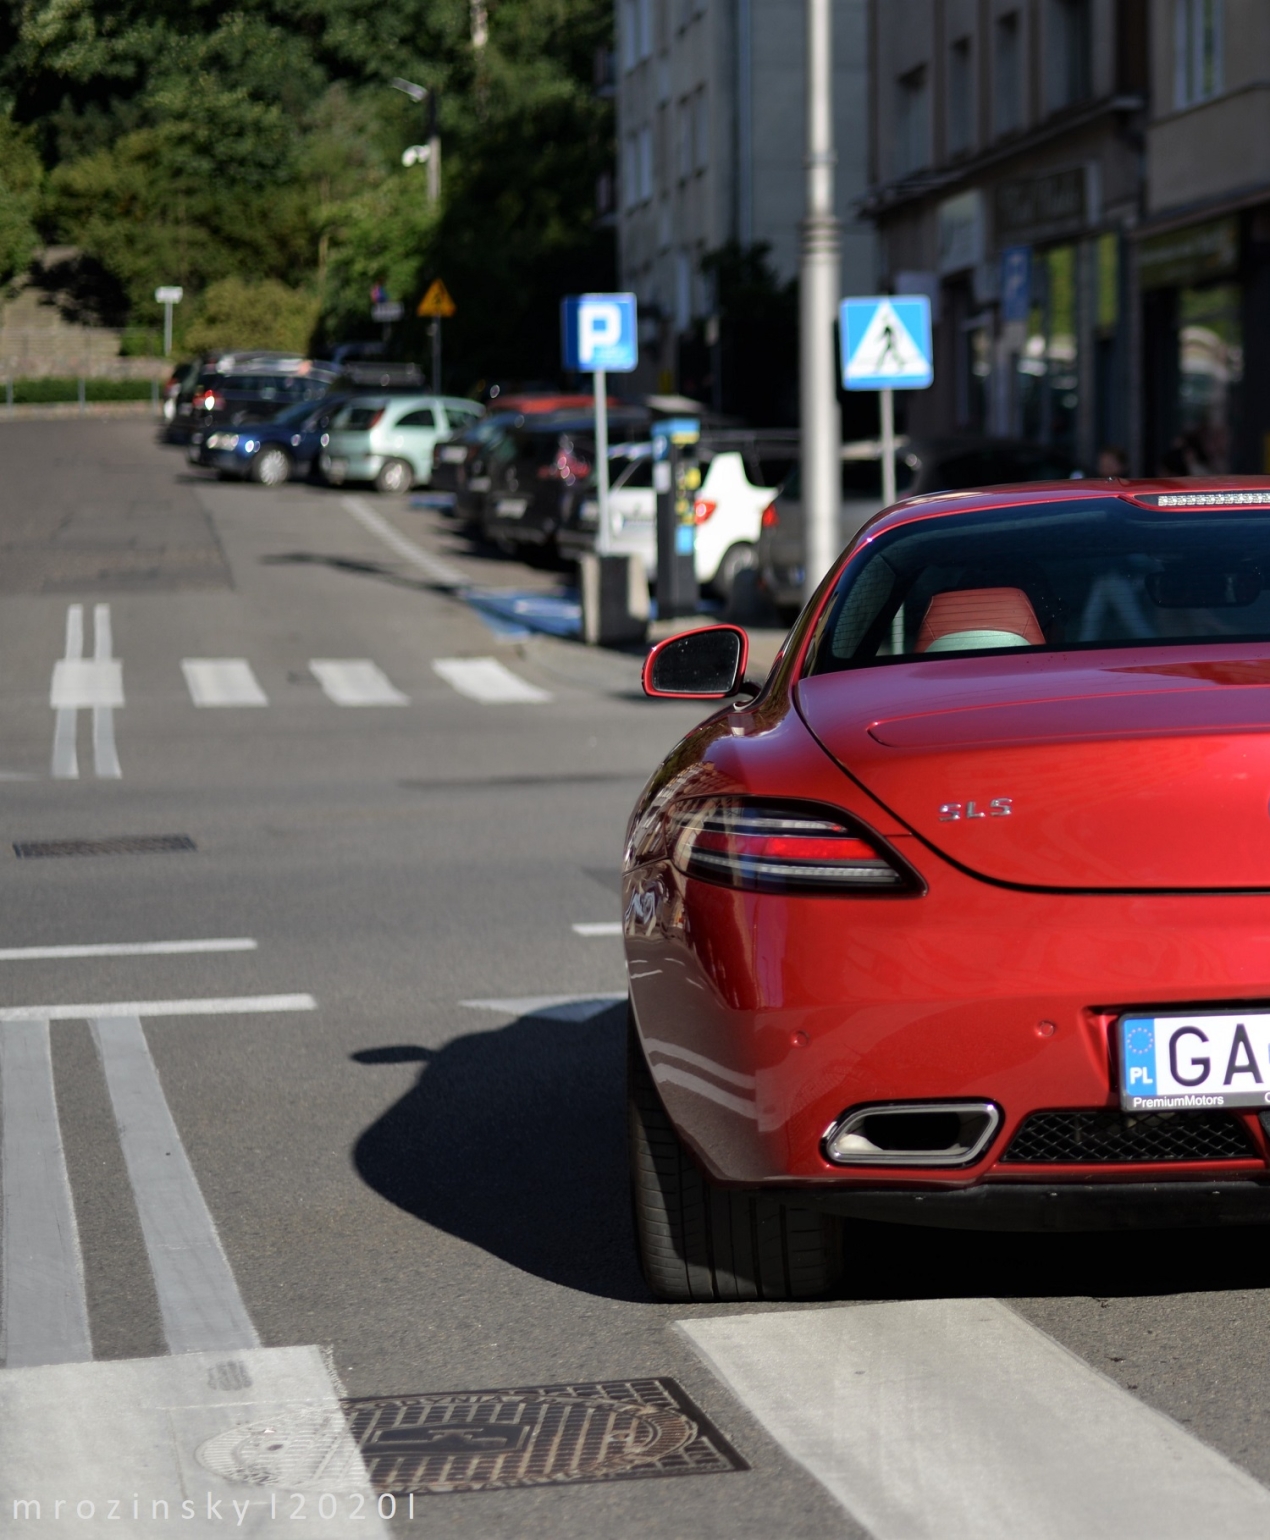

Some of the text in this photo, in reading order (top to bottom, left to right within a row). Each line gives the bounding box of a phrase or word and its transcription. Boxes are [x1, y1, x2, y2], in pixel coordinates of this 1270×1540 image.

[579, 304, 621, 364] P
[939, 797, 1013, 822] SLS
[1169, 1023, 1264, 1087] GA
[1130, 1066, 1153, 1084] PL
[1133, 1095, 1224, 1108] PremiumMotors
